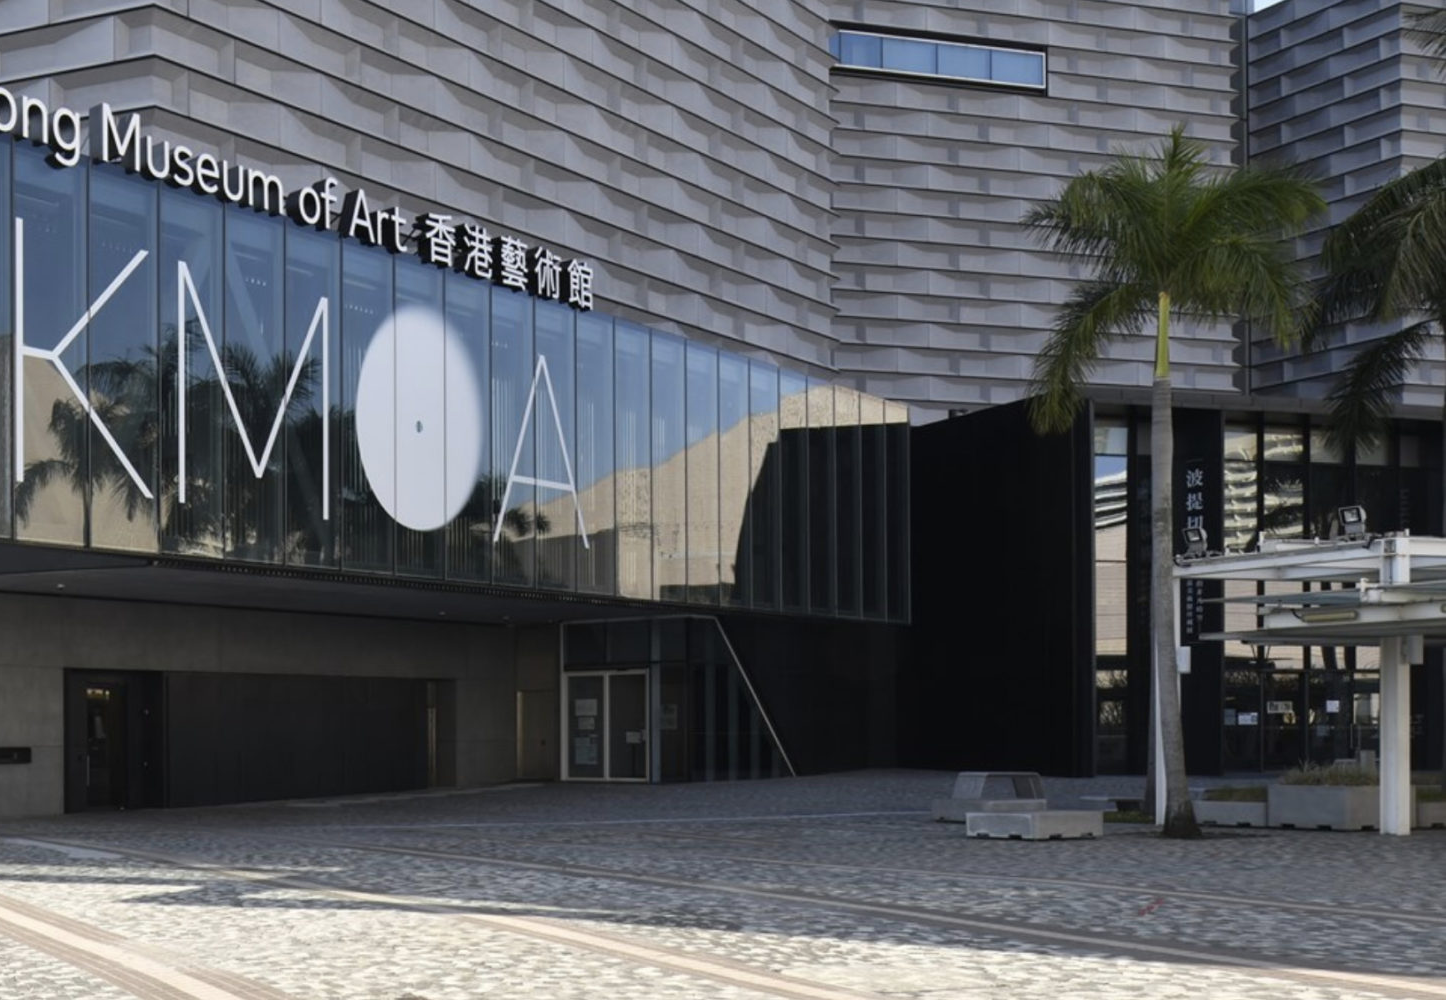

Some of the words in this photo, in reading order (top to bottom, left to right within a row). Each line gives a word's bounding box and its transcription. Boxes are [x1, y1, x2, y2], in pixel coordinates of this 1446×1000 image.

[100, 102, 286, 216] Museum
[298, 176, 339, 230] of
[348, 188, 408, 252] Art
[425, 212, 594, 311] 香港藝術館
